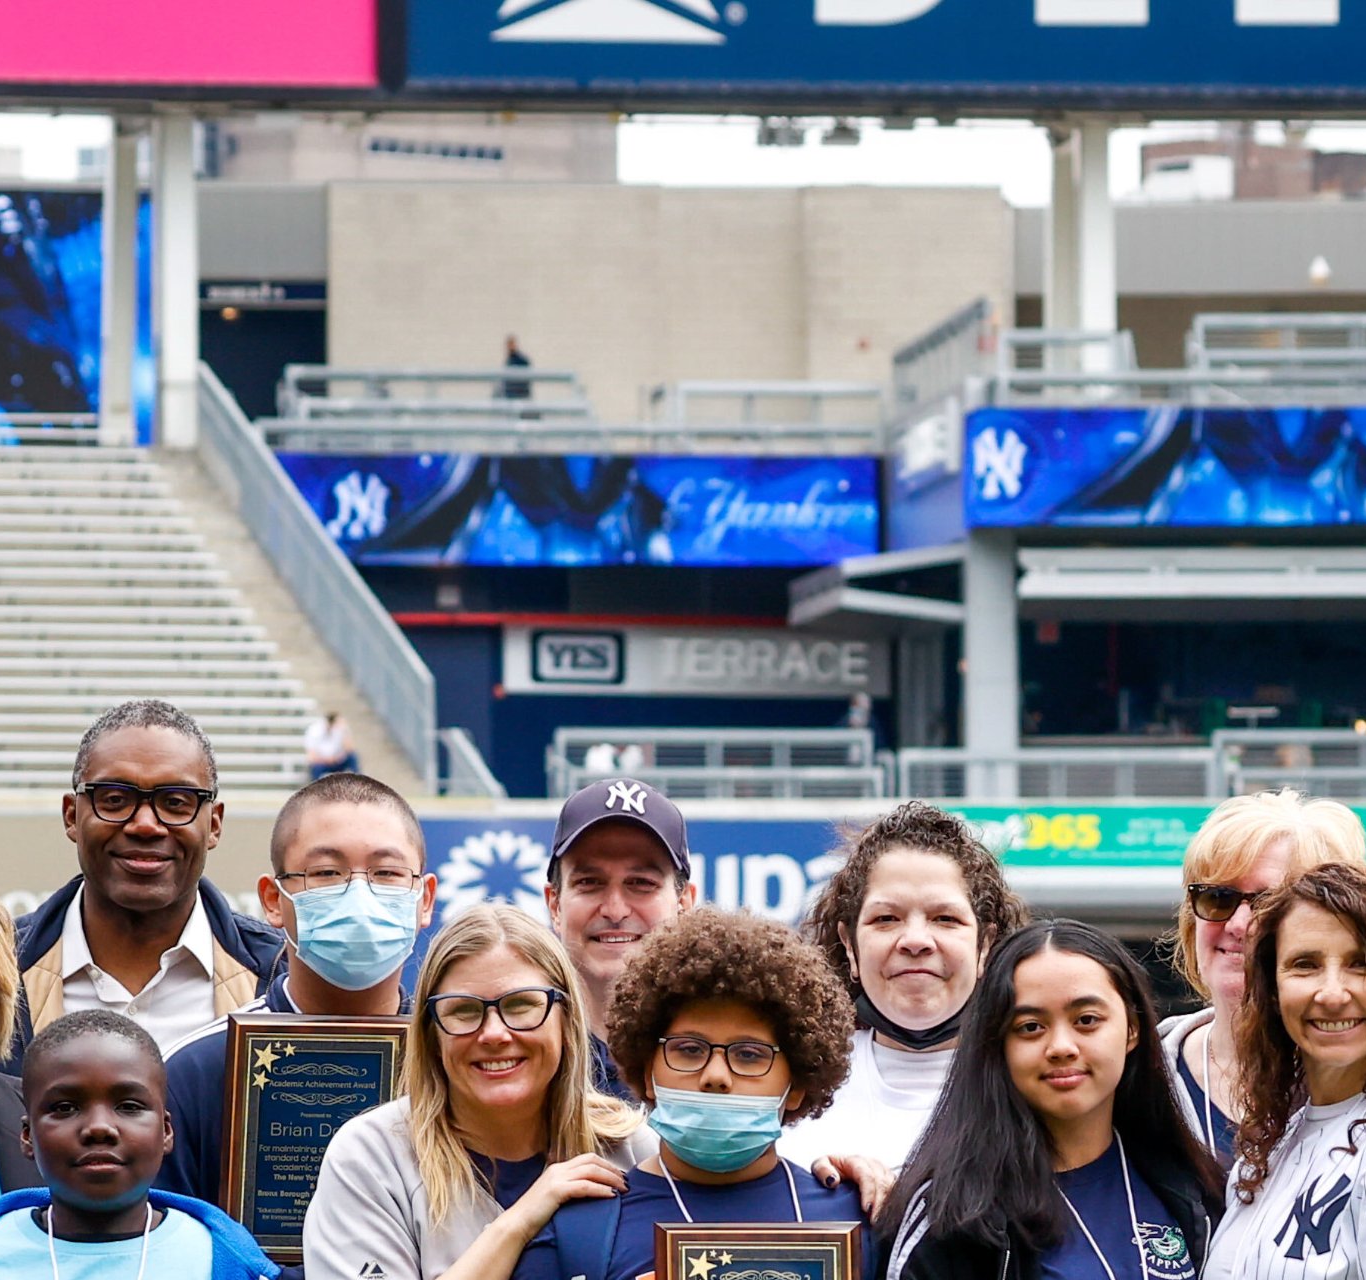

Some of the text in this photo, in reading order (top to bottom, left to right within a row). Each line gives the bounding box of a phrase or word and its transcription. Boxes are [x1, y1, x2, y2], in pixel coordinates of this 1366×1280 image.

[972, 426, 1028, 499] NY
[333, 469, 389, 539] NY
[546, 640, 869, 684] YES TERRACE
[605, 780, 649, 815] NY
[268, 1078, 376, 1089] Academic Achievement Award
[258, 1143, 318, 1154] For maintaining
[270, 1121, 313, 1137] Brian
[1274, 1173, 1352, 1260] NY
